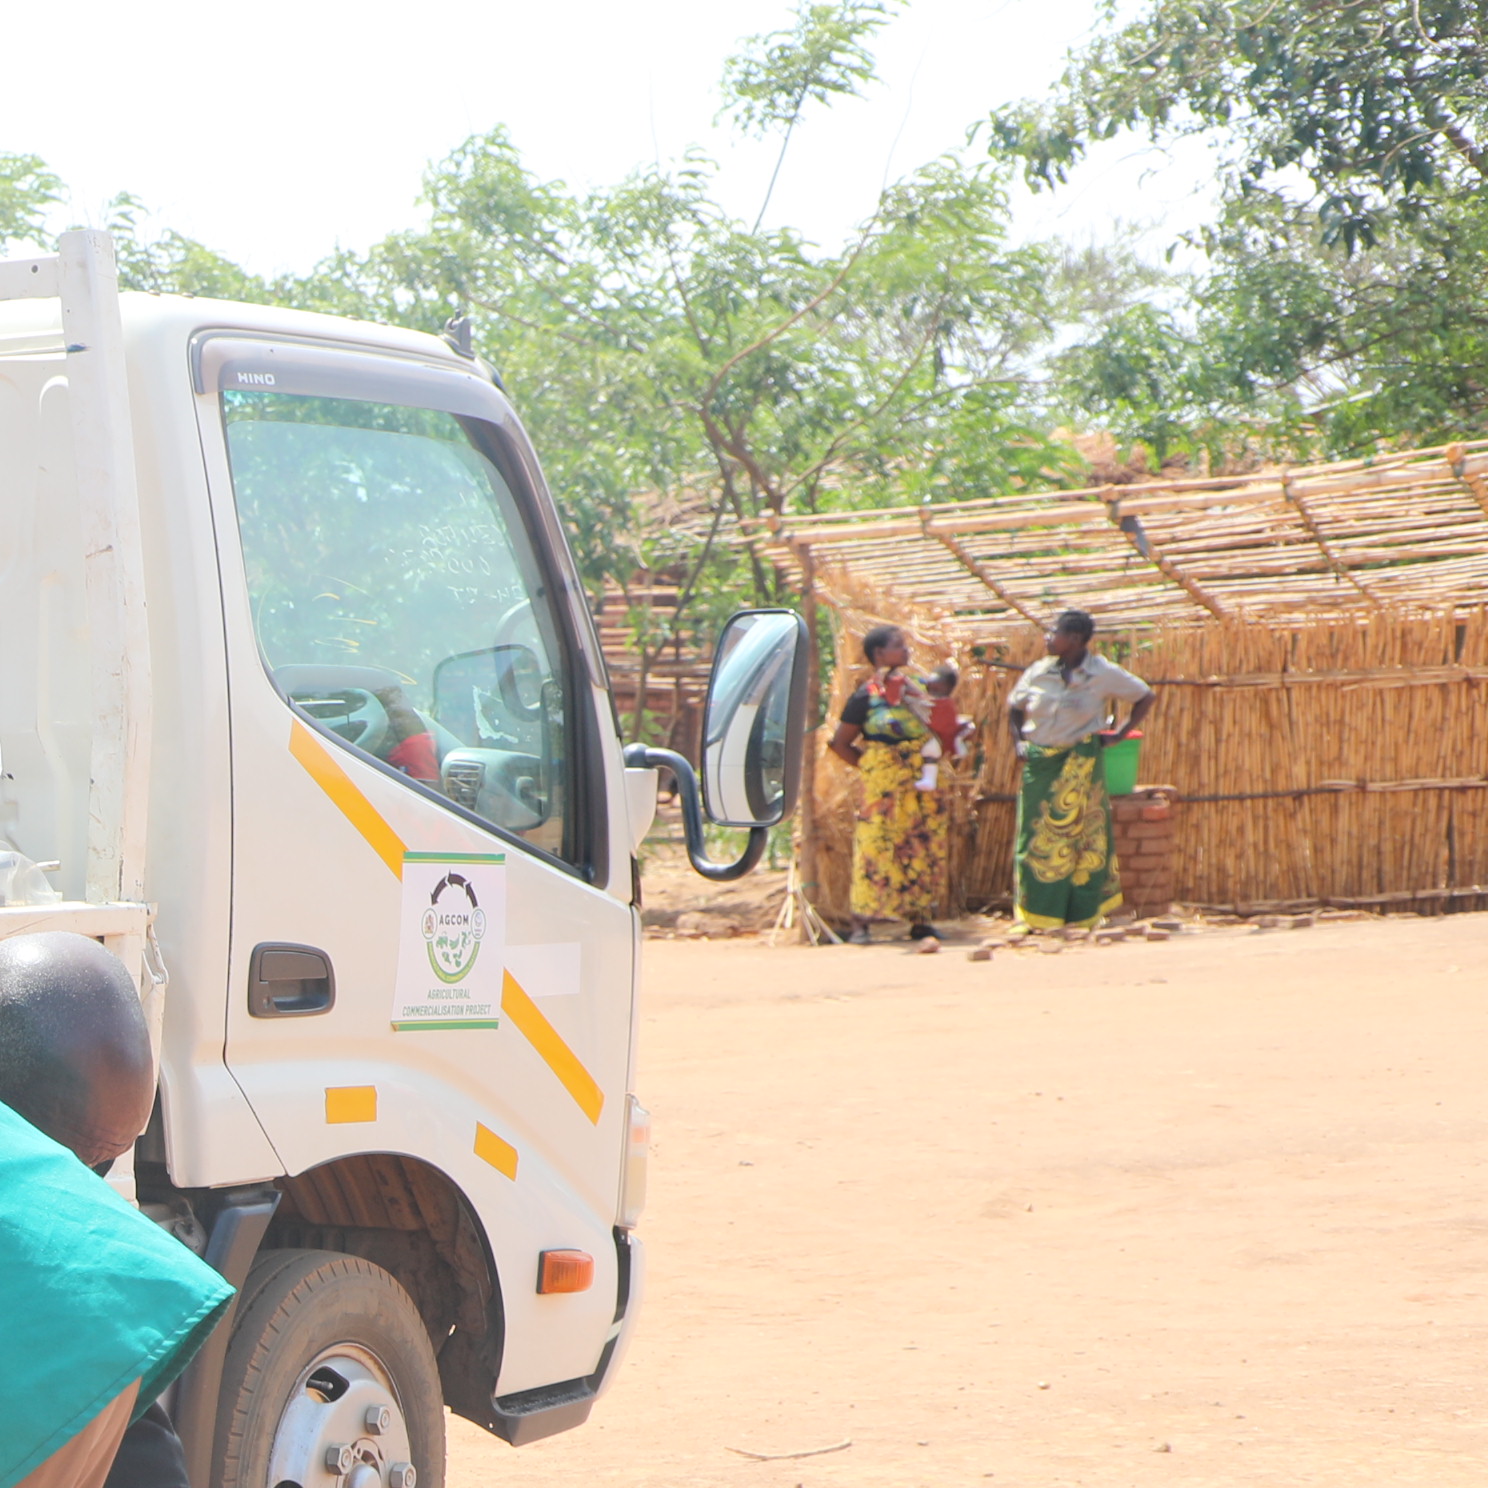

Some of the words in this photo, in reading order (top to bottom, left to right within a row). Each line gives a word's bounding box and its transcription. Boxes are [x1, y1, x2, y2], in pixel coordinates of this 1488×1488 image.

[237, 372, 276, 386] HINO
[439, 914, 470, 926] AGCOM
[427, 988, 471, 1000] AGRICULTURAL
[402, 1004, 464, 1017] COMMERCIALISATION
[464, 1003, 492, 1016] PROJECT
